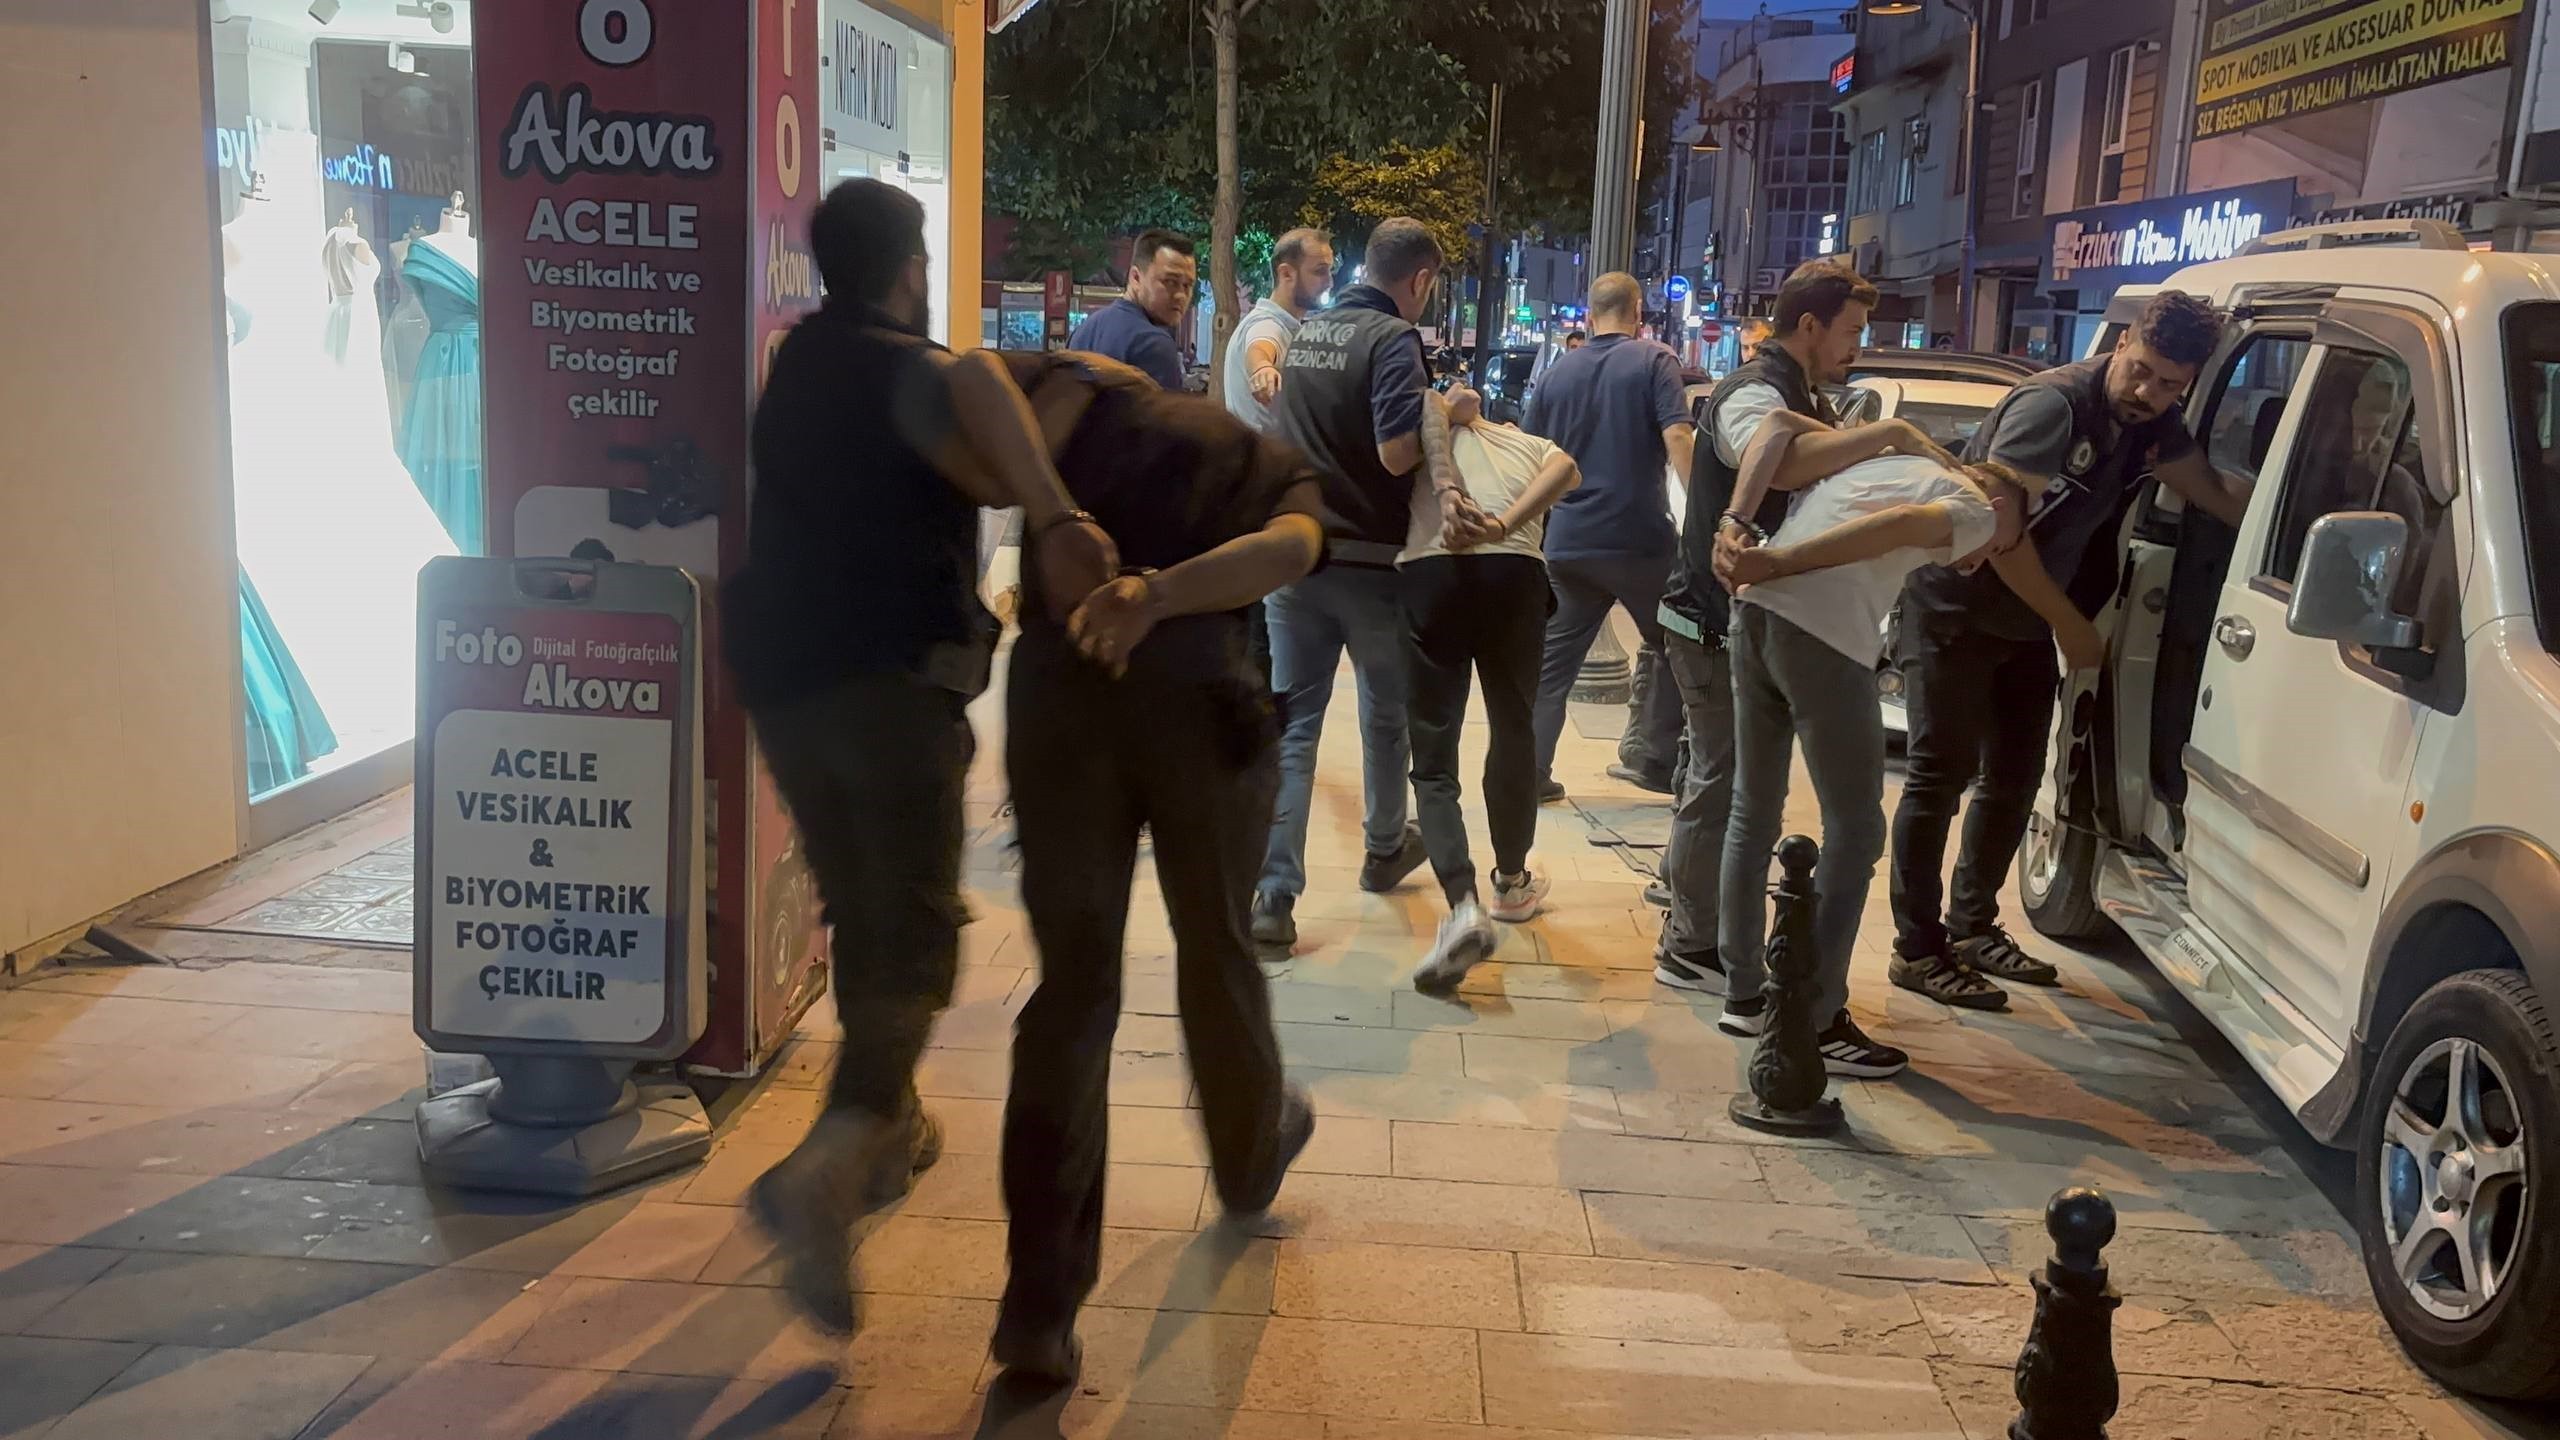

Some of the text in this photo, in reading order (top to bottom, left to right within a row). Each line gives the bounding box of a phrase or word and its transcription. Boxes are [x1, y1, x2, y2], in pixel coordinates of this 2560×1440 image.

[2202, 68, 2237, 94] SPOT
[2238, 41, 2297, 80] MOBİLYA
[2303, 32, 2322, 65] VE
[2323, 3, 2415, 57] AKSESUAR
[871, 35, 898, 133] MODA
[2215, 91, 2265, 128] BEĞENİN
[2267, 81, 2289, 119] BİZ
[2290, 74, 2347, 113] YAPALIM
[2350, 45, 2442, 98] İMALATTAN
[2444, 29, 2507, 74] HALKA
[508, 91, 714, 175] Akova
[526, 198, 699, 249] ACELE
[524, 257, 701, 292] Vesikalık ve
[766, 221, 812, 308] Akova
[531, 301, 696, 335] Biyometrik
[549, 343, 680, 380] Fotoğraf
[567, 388, 659, 419] çekilir
[436, 619, 679, 667] Foto Dijital Fotoğrafçılık
[522, 662, 660, 712] Akova
[490, 748, 598, 782] ACELE
[529, 838, 554, 868] &
[456, 918, 639, 958] FOTOĞRAF
